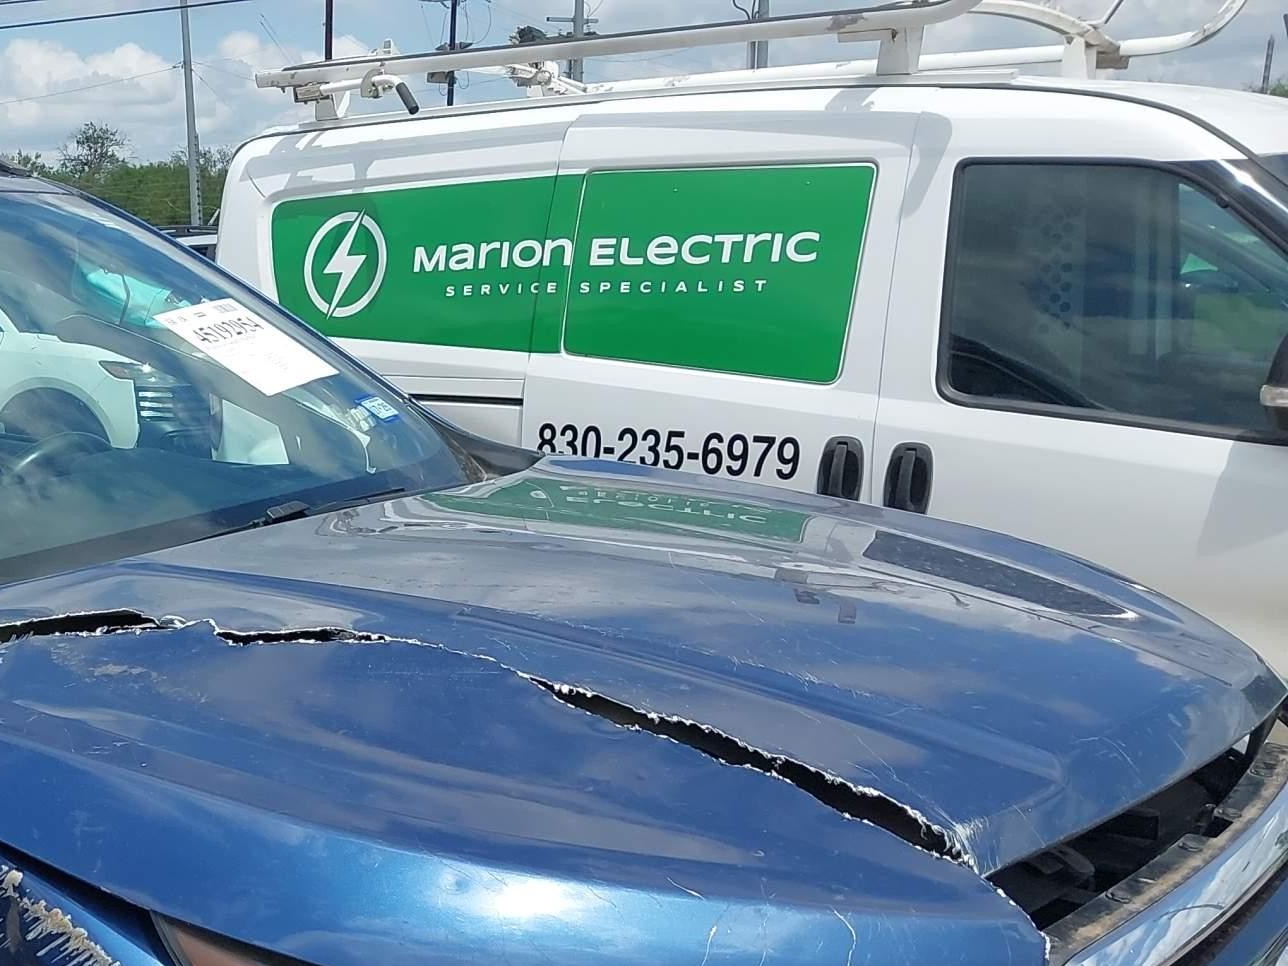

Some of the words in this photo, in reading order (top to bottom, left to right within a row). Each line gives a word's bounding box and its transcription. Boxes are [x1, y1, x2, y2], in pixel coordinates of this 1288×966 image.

[445, 282, 558, 297] SERVICE
[579, 279, 768, 294] SPECIALIST
[192, 316, 265, 345] 45192954
[537, 422, 801, 481] 830-235-6979
